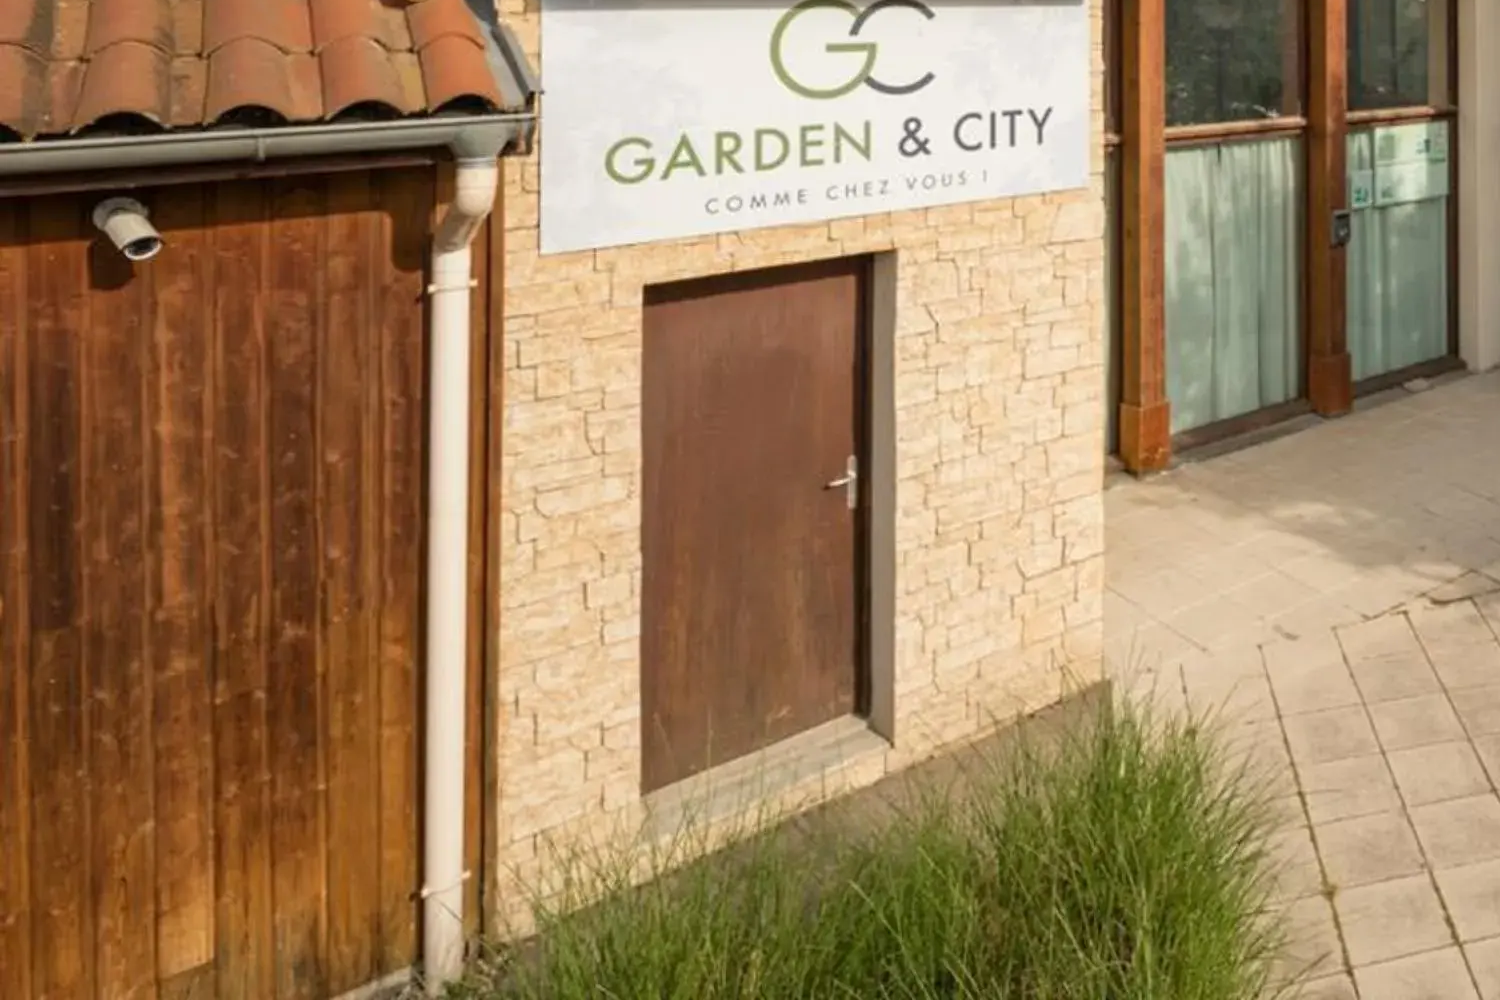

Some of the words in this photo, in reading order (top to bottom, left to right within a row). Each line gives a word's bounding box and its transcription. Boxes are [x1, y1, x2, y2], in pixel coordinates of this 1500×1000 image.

[604, 119, 873, 185] GARDEN
[897, 116, 932, 158] &
[953, 106, 1054, 152] CITY
[704, 187, 808, 216] COMME
[825, 179, 891, 202] CHEZ
[905, 169, 968, 191] VOUS
